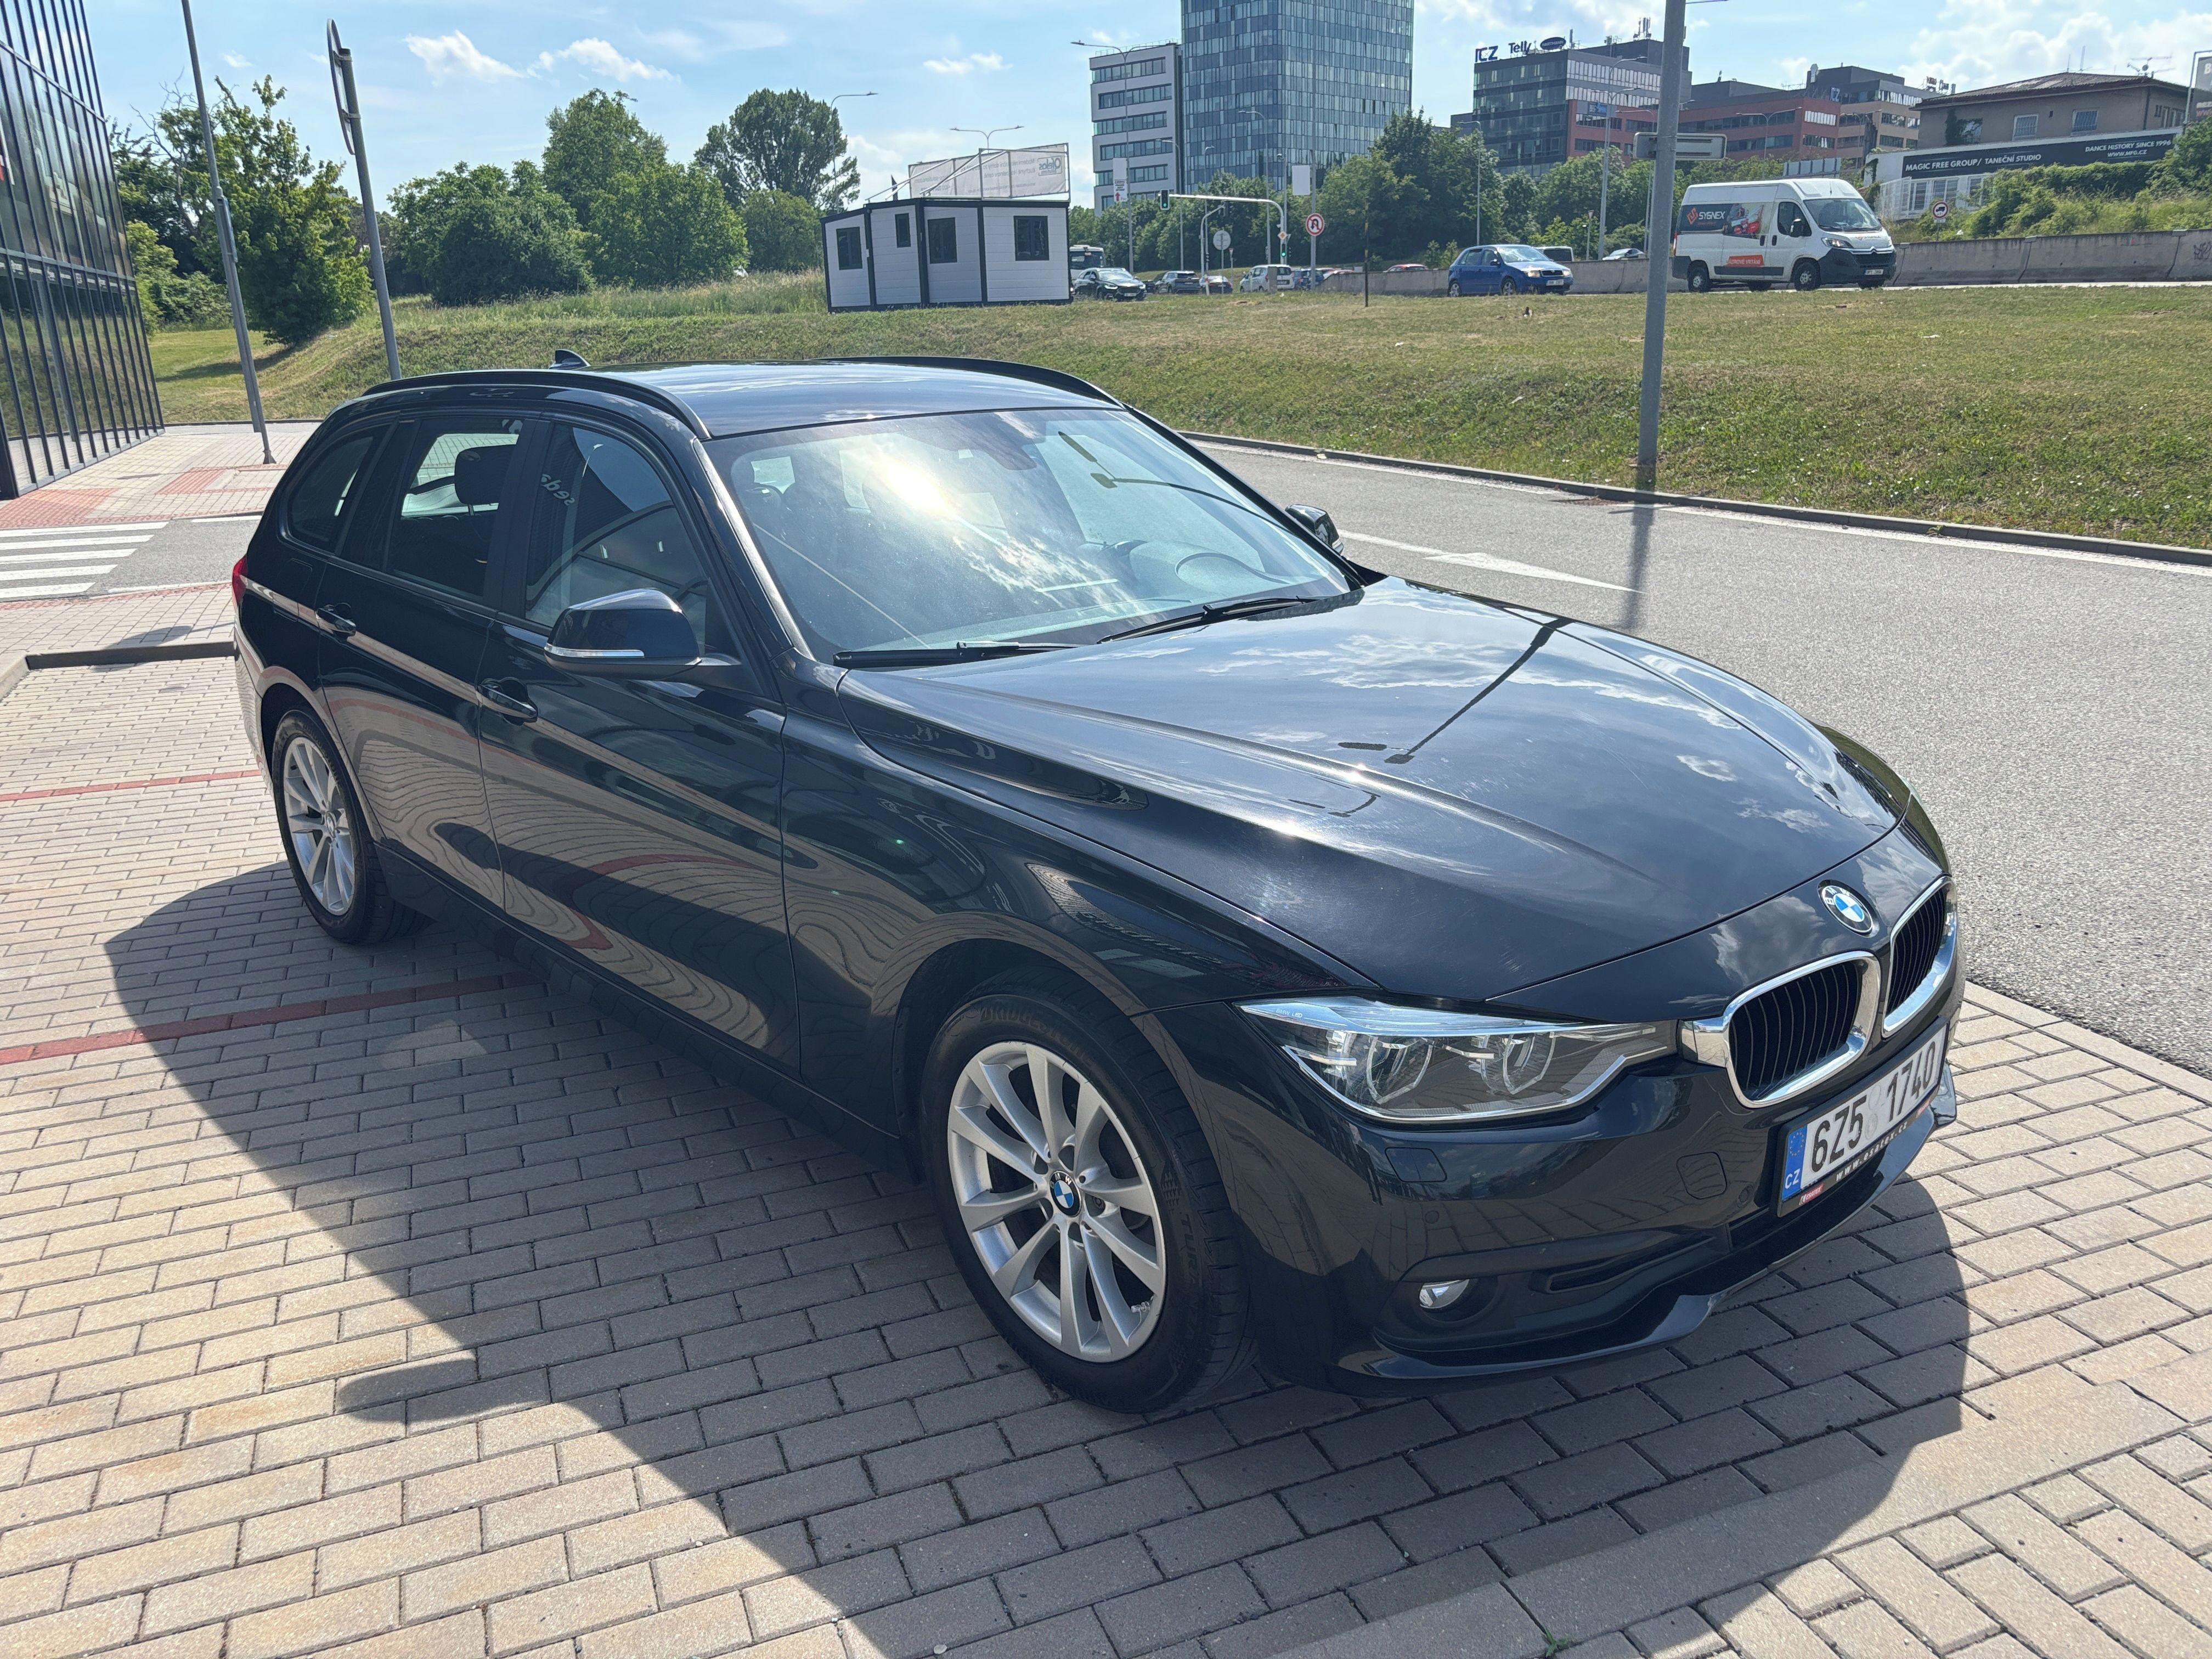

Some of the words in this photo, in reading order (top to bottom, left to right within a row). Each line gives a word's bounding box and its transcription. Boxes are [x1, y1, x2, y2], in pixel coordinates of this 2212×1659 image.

[1475, 46, 1498, 63] ICZ
[1508, 41, 1532, 55] Telly
[1905, 162, 1931, 171] MAGIC
[1931, 161, 1949, 169] FREE
[1985, 155, 2015, 165] TANEČNÍ
[2016, 154, 2042, 162] STUDIO
[1810, 1094, 1867, 1173] 6Z5
[1887, 1041, 1937, 1124] 1740
[1835, 1121, 1909, 1183] www.esatex.cz
[1049, 1172, 1072, 1189] BMW
[1784, 1169, 1801, 1190] CZ
